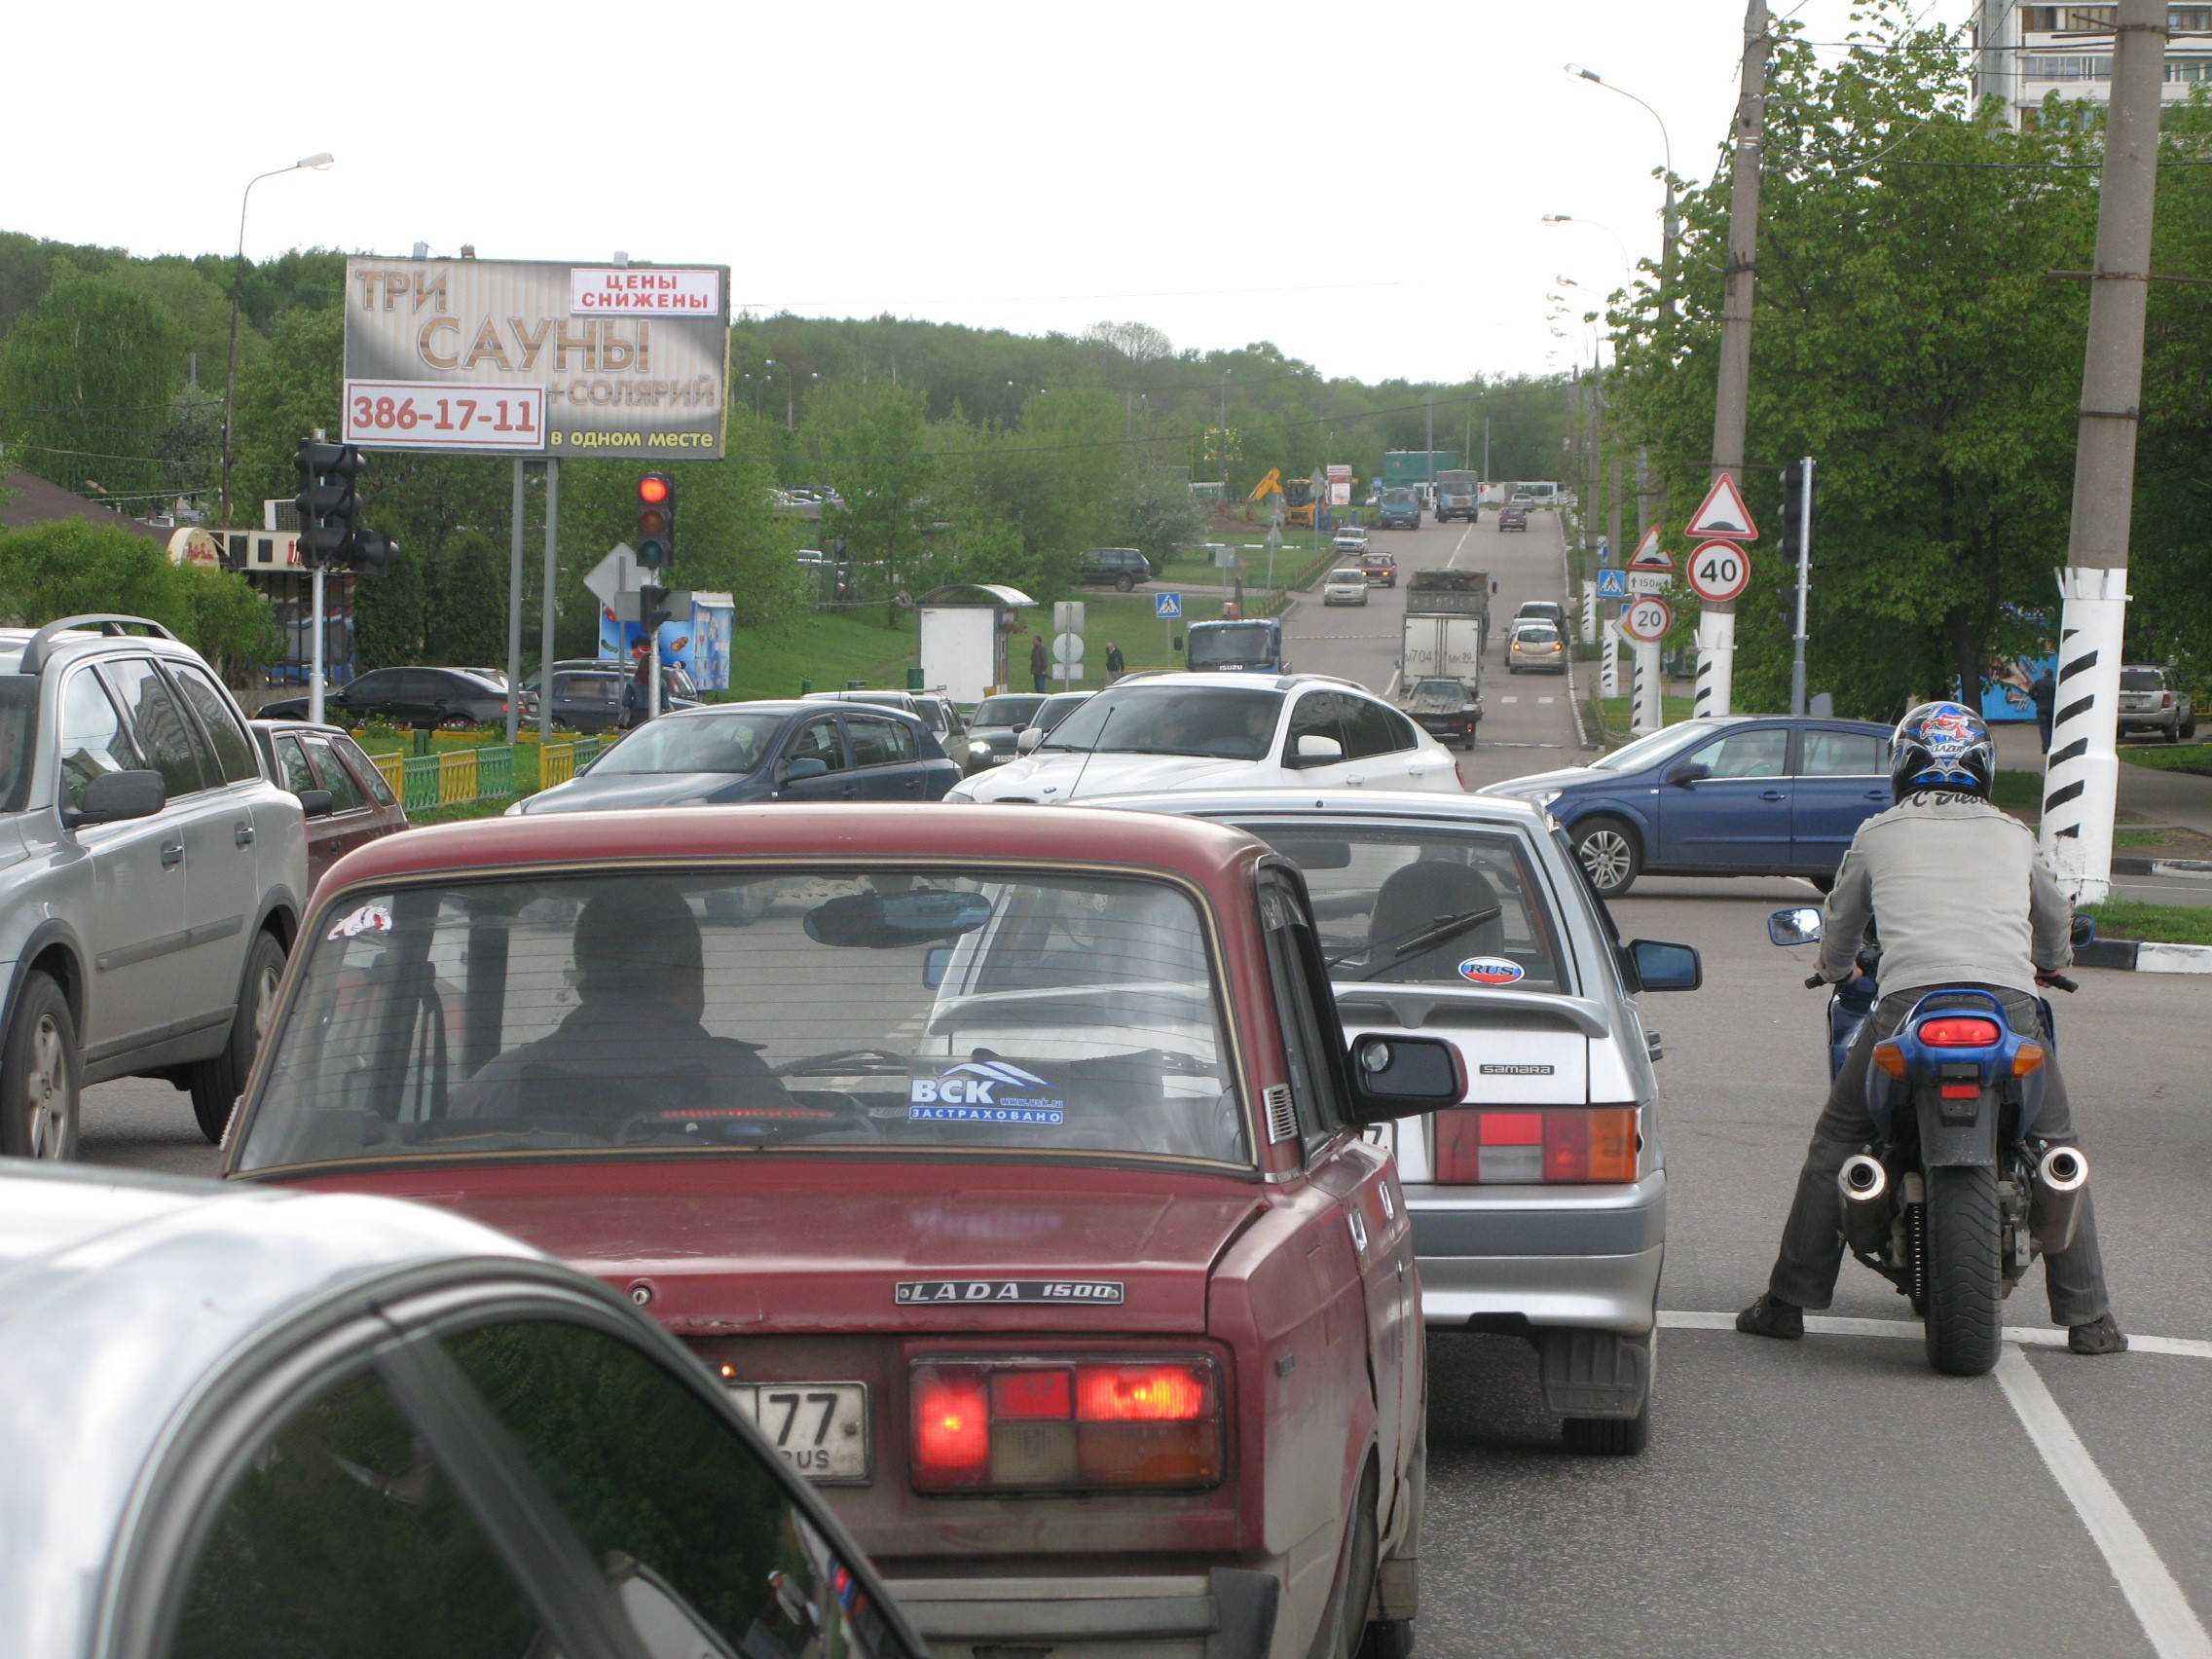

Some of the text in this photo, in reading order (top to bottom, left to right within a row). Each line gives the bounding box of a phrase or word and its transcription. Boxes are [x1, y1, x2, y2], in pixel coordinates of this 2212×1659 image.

[356, 269, 447, 313] ТРИ
[606, 275, 678, 291] ЦЕНЫ
[581, 292, 709, 309] СНИЖЕНЫ
[418, 313, 650, 372] САУНЫ
[351, 396, 535, 431] 386-17-11
[571, 431, 642, 448] одном
[647, 432, 715, 448] месте
[1700, 558, 1737, 582] 40
[1638, 609, 1661, 627] 20
[1469, 964, 1515, 976] RUS
[910, 1079, 996, 1104] ВСК
[1000, 1097, 1063, 1109] www.vsk.ru
[911, 1109, 1061, 1123] ЗАСТРАХОВАНО
[910, 1283, 1113, 1301] LADA 1500
[769, 1393, 837, 1446] 77
